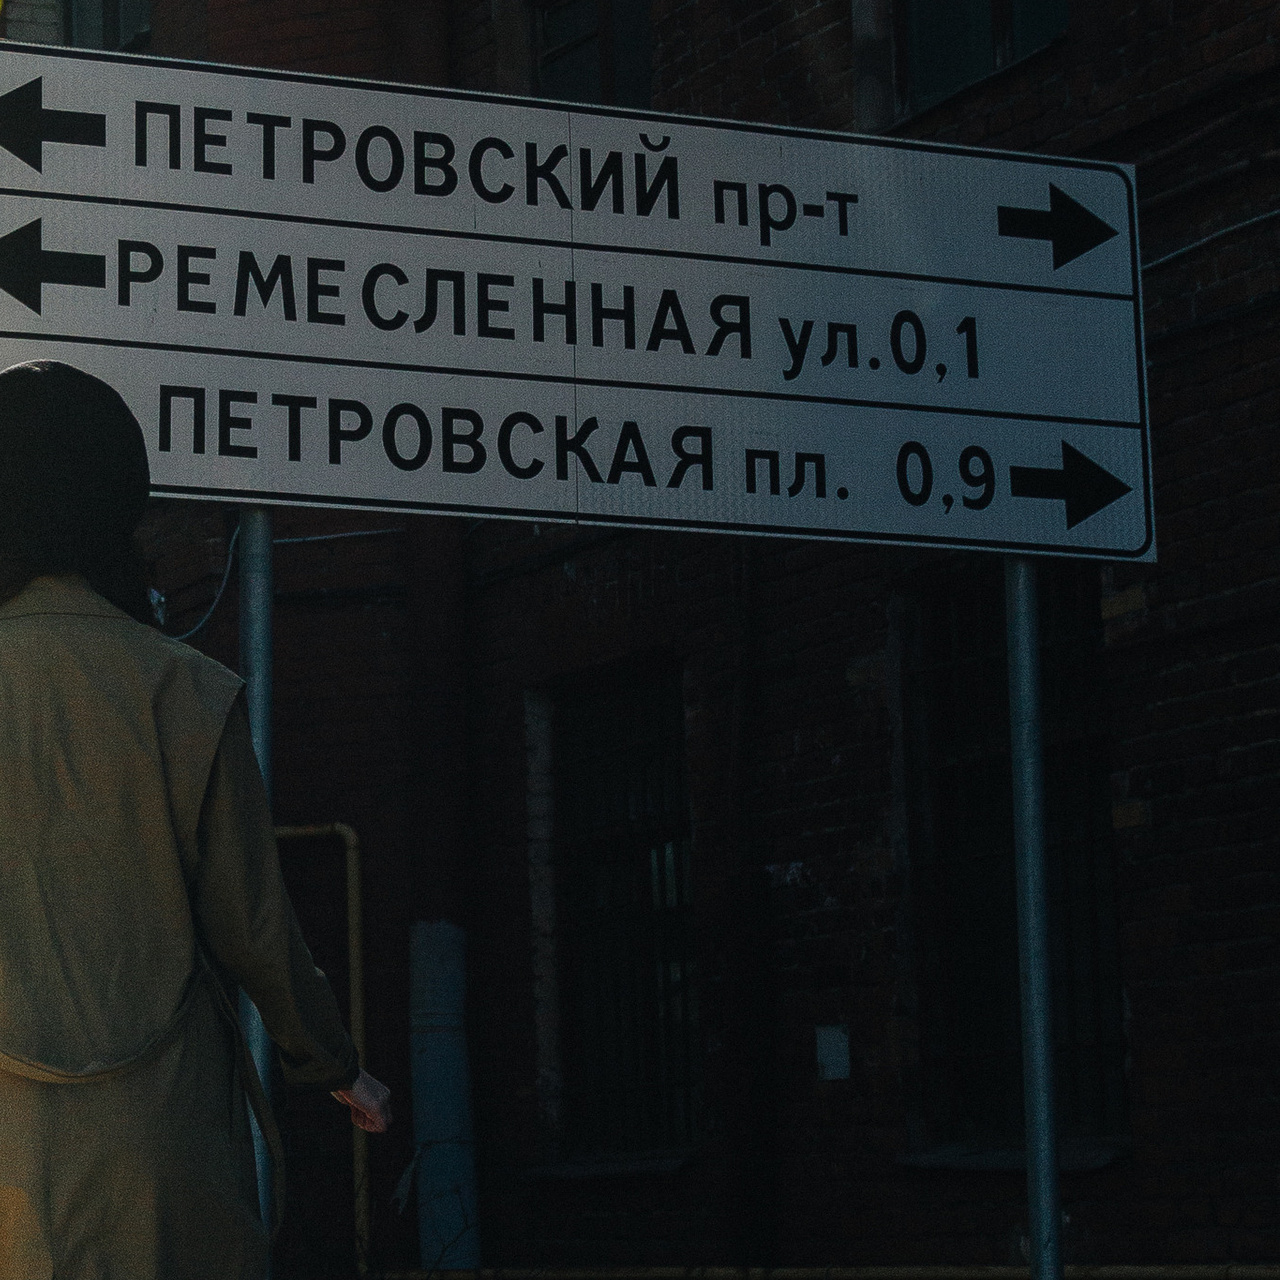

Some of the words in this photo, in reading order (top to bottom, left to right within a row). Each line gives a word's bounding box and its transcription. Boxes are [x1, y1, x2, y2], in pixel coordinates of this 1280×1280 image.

[135, 100, 680, 220] ПЕТРОВСКИЙ
[713, 180, 858, 246] пр-т
[118, 239, 752, 359] РЕМЕСЛЕННАЯ
[158, 384, 714, 491] ПЕТРОВСКАЯ
[745, 448, 849, 500] пл.
[897, 441, 995, 514] 0,9
